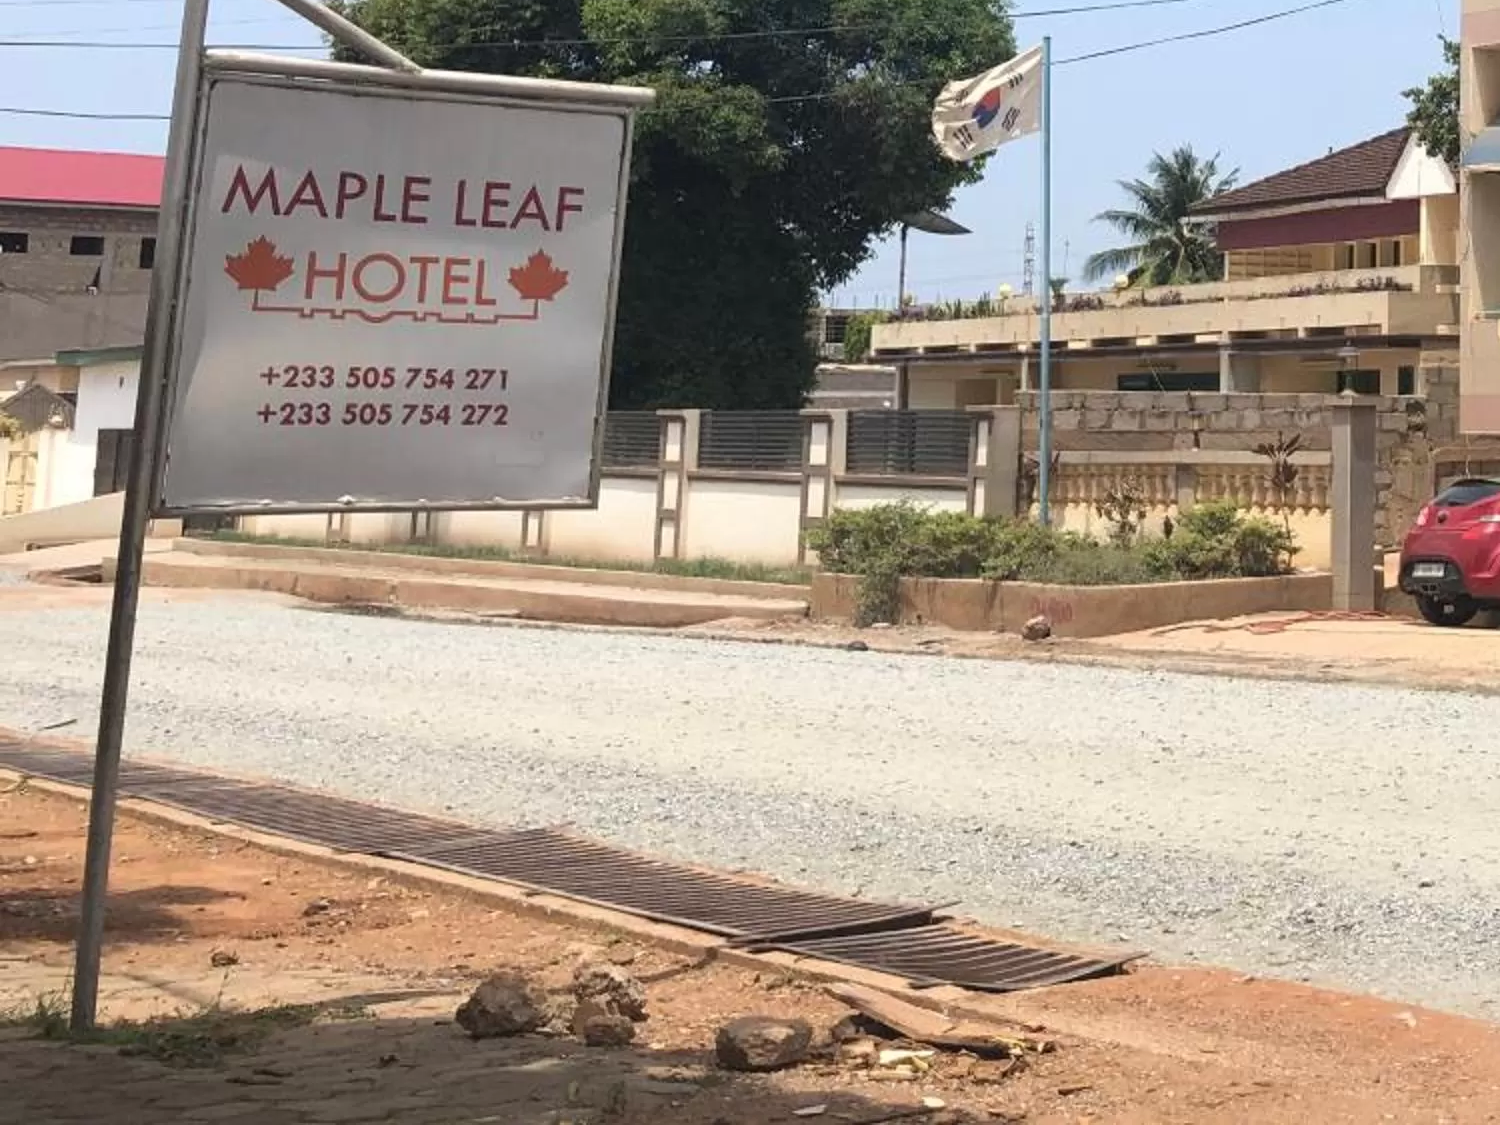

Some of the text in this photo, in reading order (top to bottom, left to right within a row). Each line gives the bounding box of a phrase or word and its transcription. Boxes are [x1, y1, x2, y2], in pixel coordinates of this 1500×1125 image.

[221, 165, 585, 232] MAPLE LEAF
[304, 250, 498, 306] HOTEL
[259, 366, 510, 391] +233 505 754 271
[256, 403, 509, 427] +233 505 754 272
